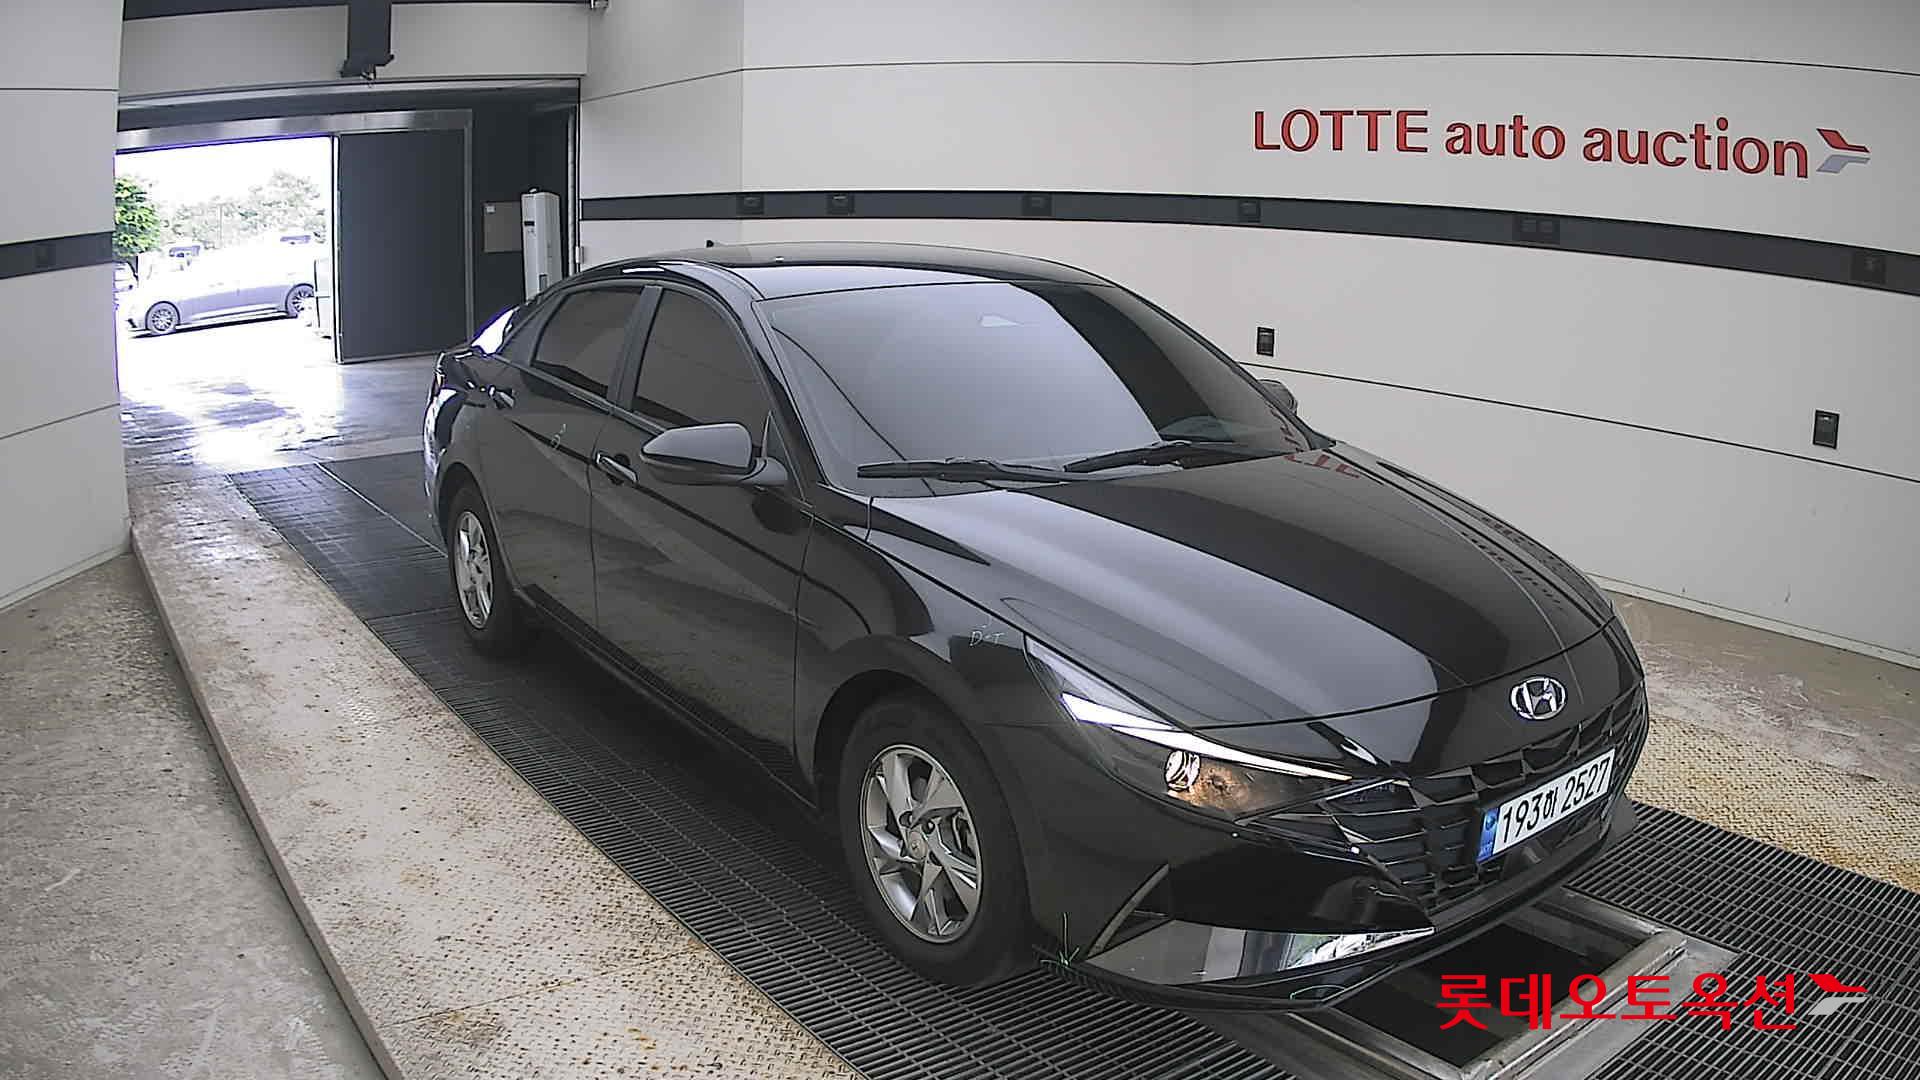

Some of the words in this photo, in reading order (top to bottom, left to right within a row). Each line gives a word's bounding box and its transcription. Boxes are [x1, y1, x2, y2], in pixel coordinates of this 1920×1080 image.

[1253, 110, 1429, 153] LOTTE
[1445, 114, 1567, 161] auto
[1581, 116, 1809, 179] auction
[1560, 756, 1612, 814] 2527
